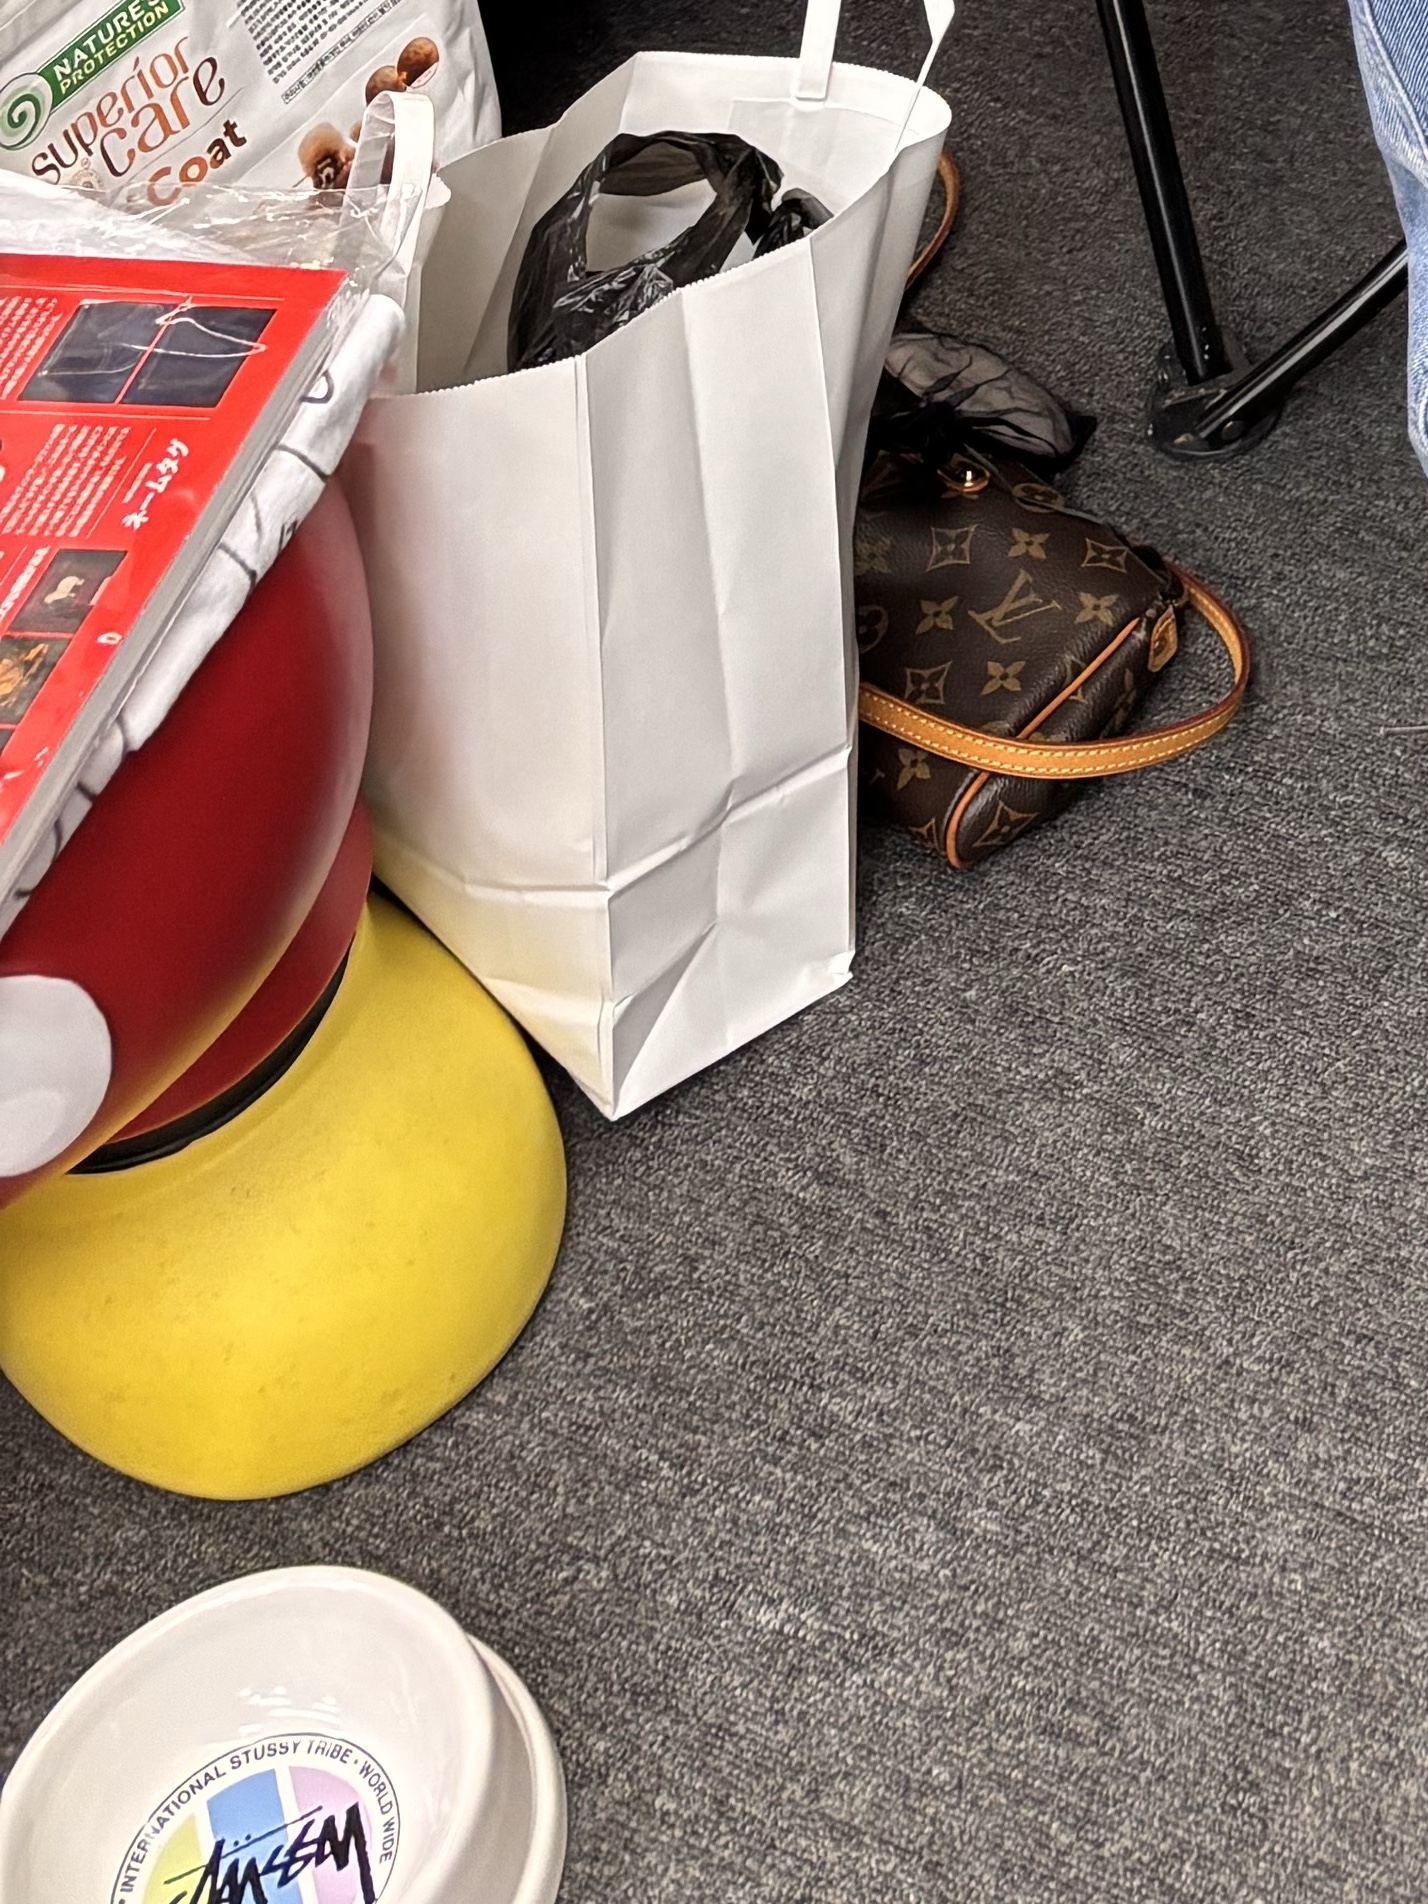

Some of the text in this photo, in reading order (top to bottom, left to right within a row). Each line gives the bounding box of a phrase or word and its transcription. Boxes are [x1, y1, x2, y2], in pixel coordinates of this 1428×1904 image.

[31, 36, 189, 185] superior
[59, 0, 169, 96] PROTECTION
[99, 56, 225, 177] care
[119, 1765, 226, 1893] INTERNATIONAL
[306, 1740, 353, 1765] TRIBE
[358, 1760, 393, 1815] WORLD
[379, 1816, 397, 1865] WIDE
